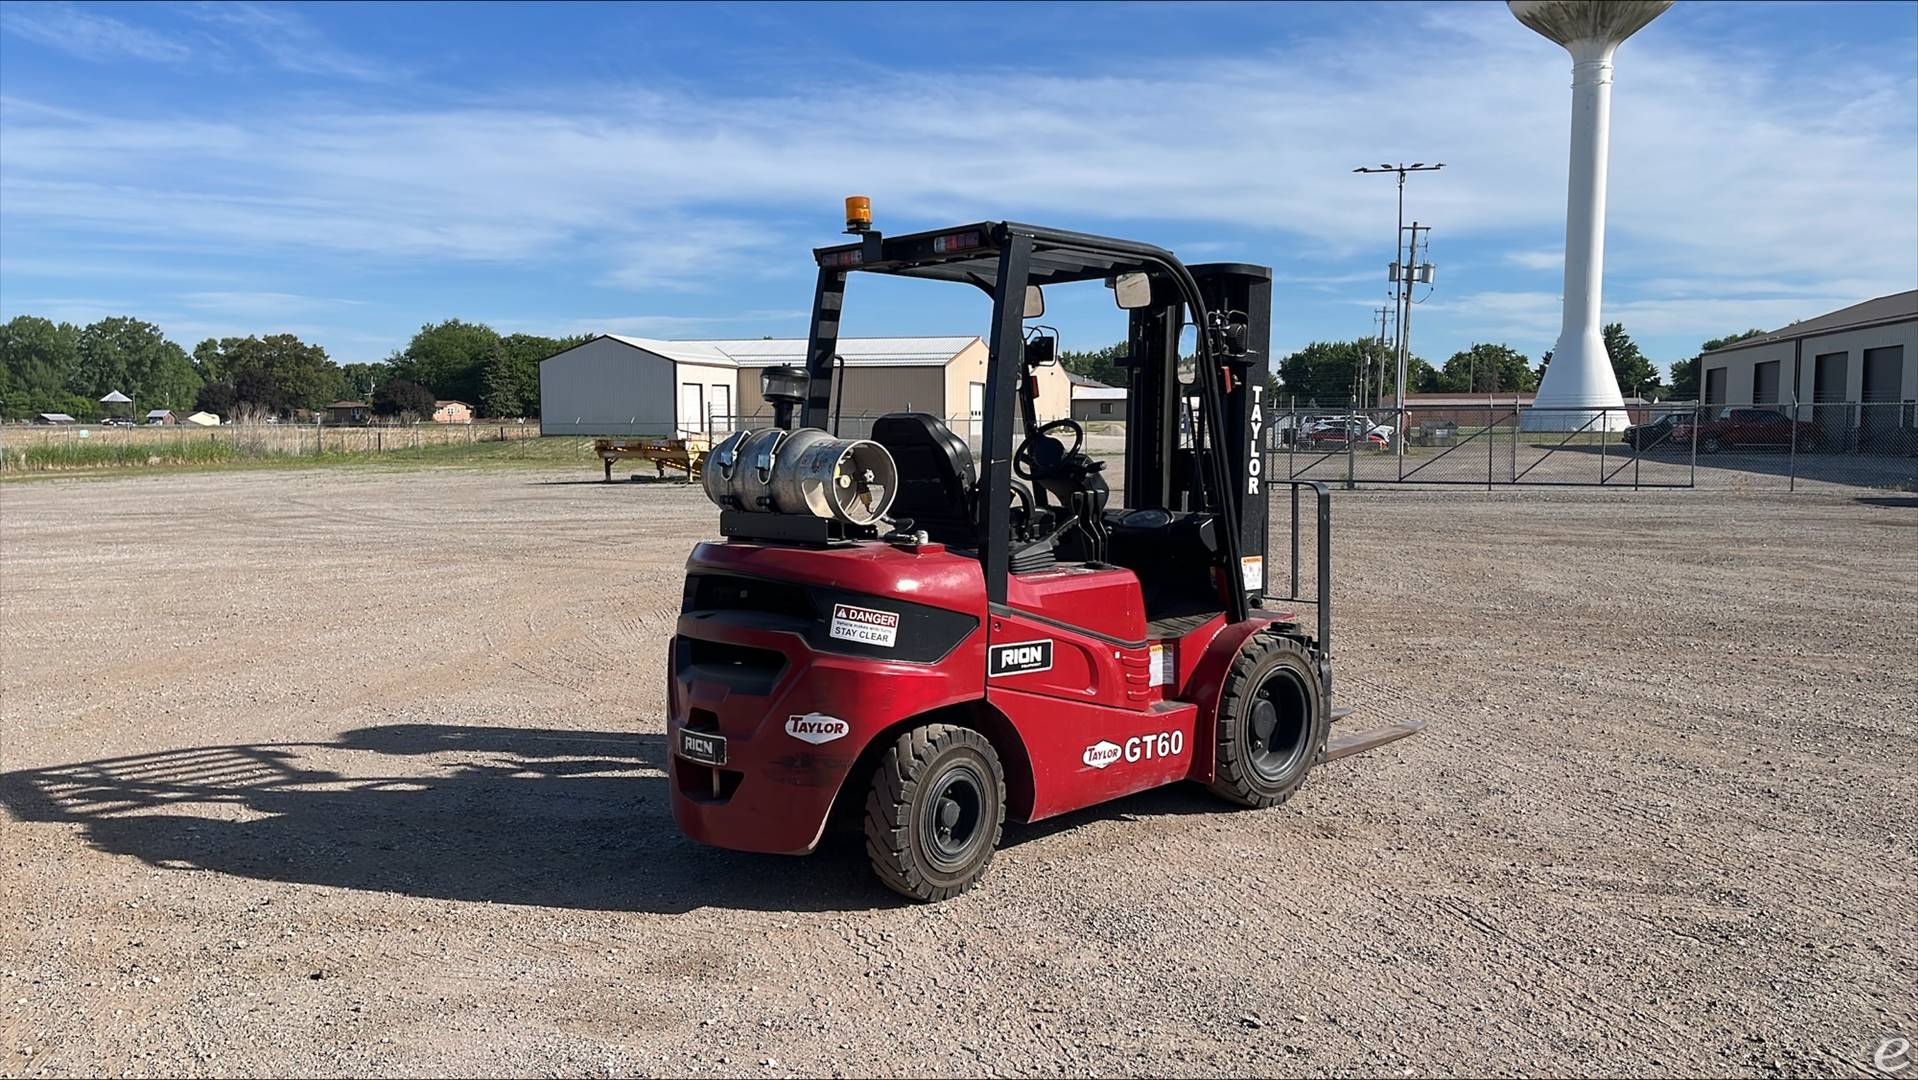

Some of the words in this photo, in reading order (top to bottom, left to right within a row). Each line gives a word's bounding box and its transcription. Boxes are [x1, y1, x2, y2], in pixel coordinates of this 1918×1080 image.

[1248, 386, 1263, 494] TAYLOR
[849, 609, 896, 627] DANGER
[835, 626, 857, 637] STAY
[859, 631, 889, 642] CLEAR
[1001, 646, 1042, 669] RION
[790, 716, 844, 734] TAYLOR
[1088, 748, 1118, 761] TAYLOR
[1125, 730, 1183, 763] GT60
